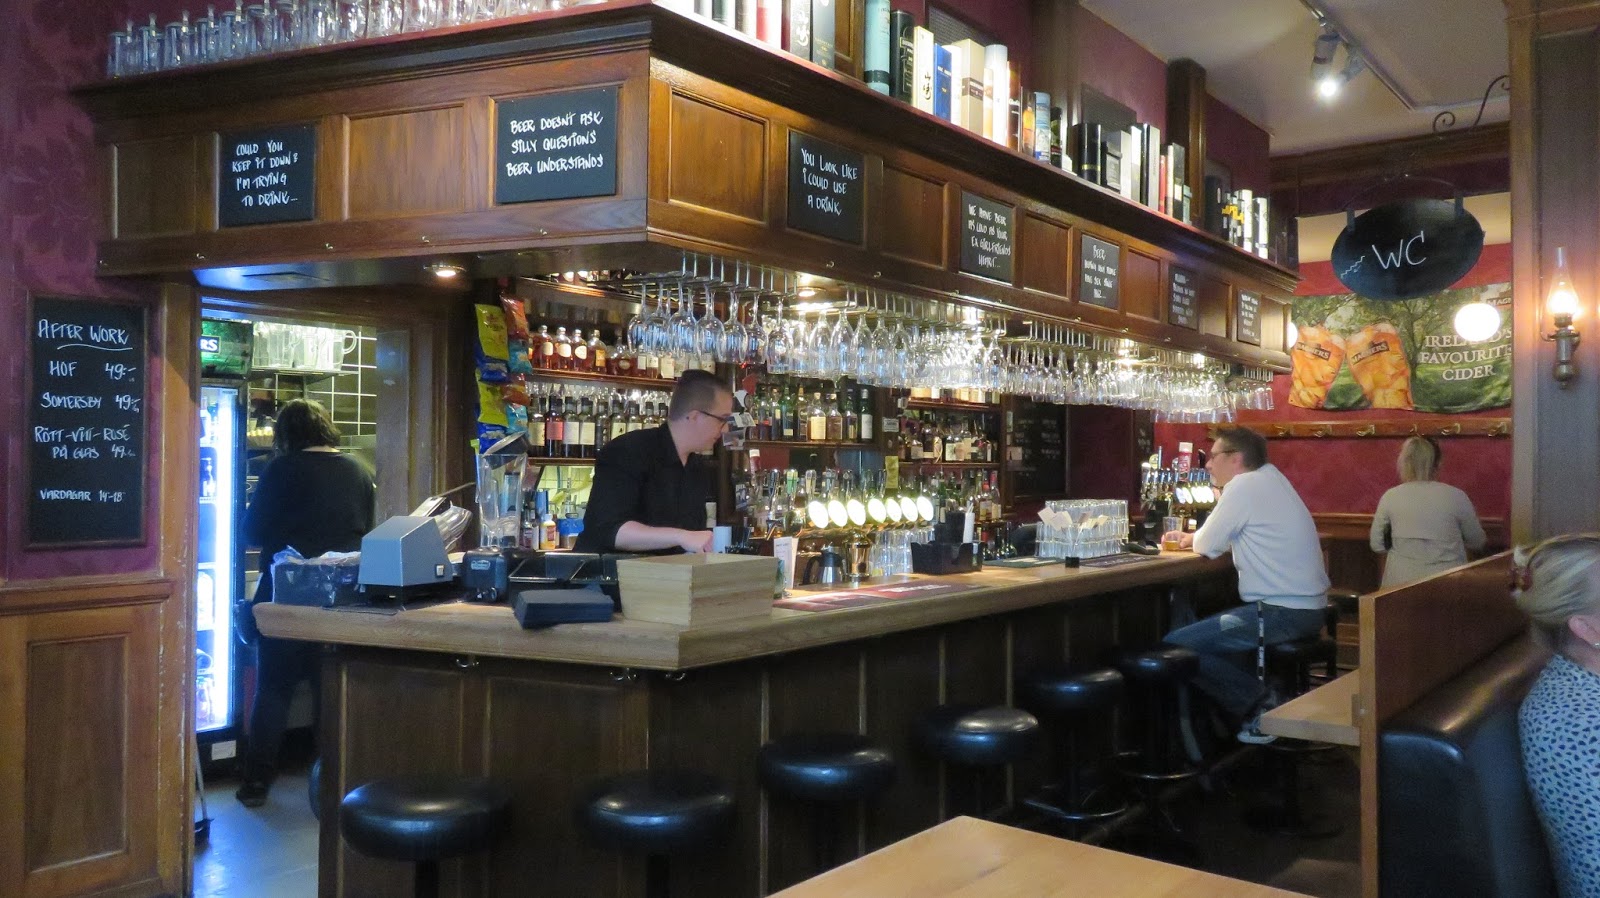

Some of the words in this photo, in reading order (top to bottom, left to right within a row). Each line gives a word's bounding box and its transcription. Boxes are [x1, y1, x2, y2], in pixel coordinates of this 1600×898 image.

[510, 120, 535, 135] BEER
[580, 111, 604, 126] ASK
[236, 144, 259, 156] COULD
[267, 140, 283, 153] YOU
[511, 139, 538, 155] SILLY
[542, 129, 597, 151] QUESTIONS
[232, 160, 252, 173] KEEP
[255, 157, 266, 169] IT
[506, 162, 533, 177] BEER
[537, 153, 604, 174] UNDERSTANDS
[801, 148, 815, 166] YOU
[819, 155, 838, 175] LOOK
[841, 164, 858, 180] LIKE
[236, 177, 250, 191] I'M
[252, 172, 287, 189] TRYING
[808, 172, 828, 190] COULD
[833, 181, 847, 195] USE
[241, 195, 253, 207] TO
[807, 194, 813, 209] A
[968, 204, 976, 216] WE
[1371, 230, 1426, 270] WC
[38, 319, 83, 341] AFTER
[89, 325, 129, 345] WORK
[1425, 328, 1511, 348] IRELD'S
[1420, 344, 1512, 364] FAVOURITE
[49, 360, 77, 377] HOF
[1442, 365, 1496, 381] CIDER
[41, 392, 102, 409] SOMERSBY
[52, 445, 68, 459] PÅ
[73, 447, 100, 459] GLAS
[40, 488, 91, 501] VARDAGAR
